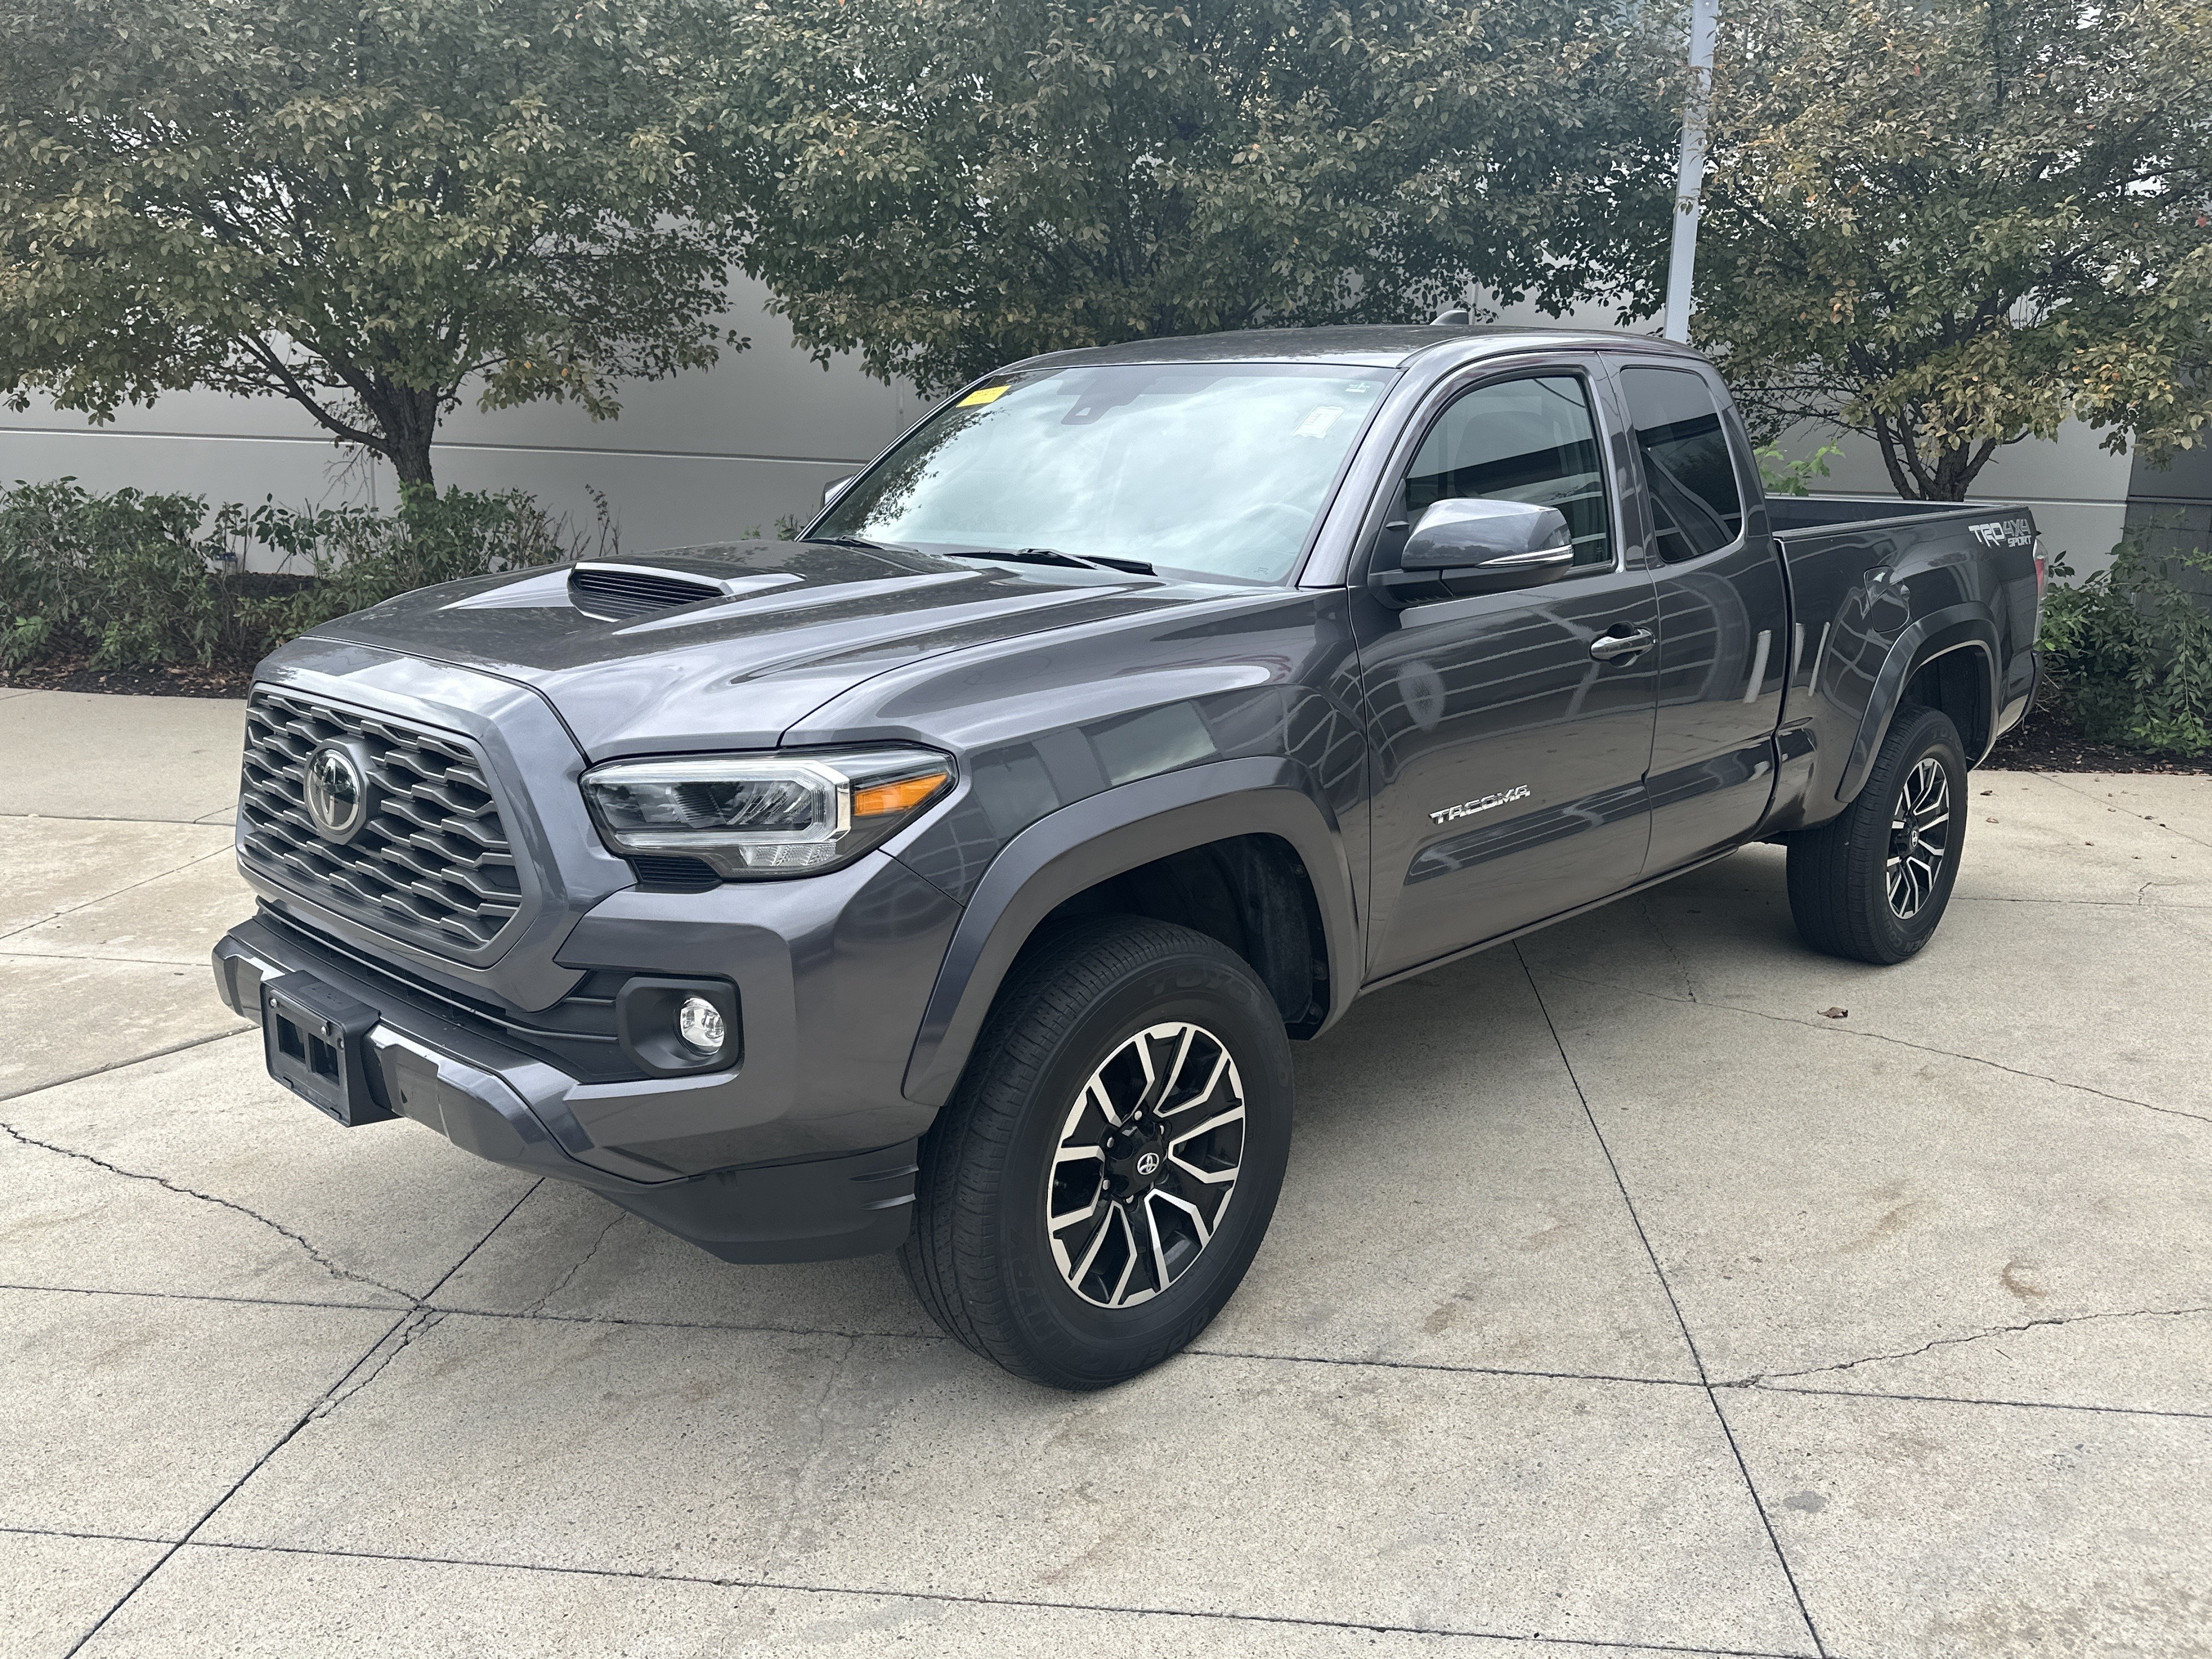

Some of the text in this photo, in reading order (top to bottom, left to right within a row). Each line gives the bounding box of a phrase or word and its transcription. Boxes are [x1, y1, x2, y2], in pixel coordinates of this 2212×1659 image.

[1968, 522, 2005, 548] TRD
[2007, 535, 2032, 548] SPORT
[1428, 784, 1531, 825] TACOMA
[1146, 964, 1252, 1005] TOYO
[1009, 1227, 1211, 1373] OPEN COUNTRY
